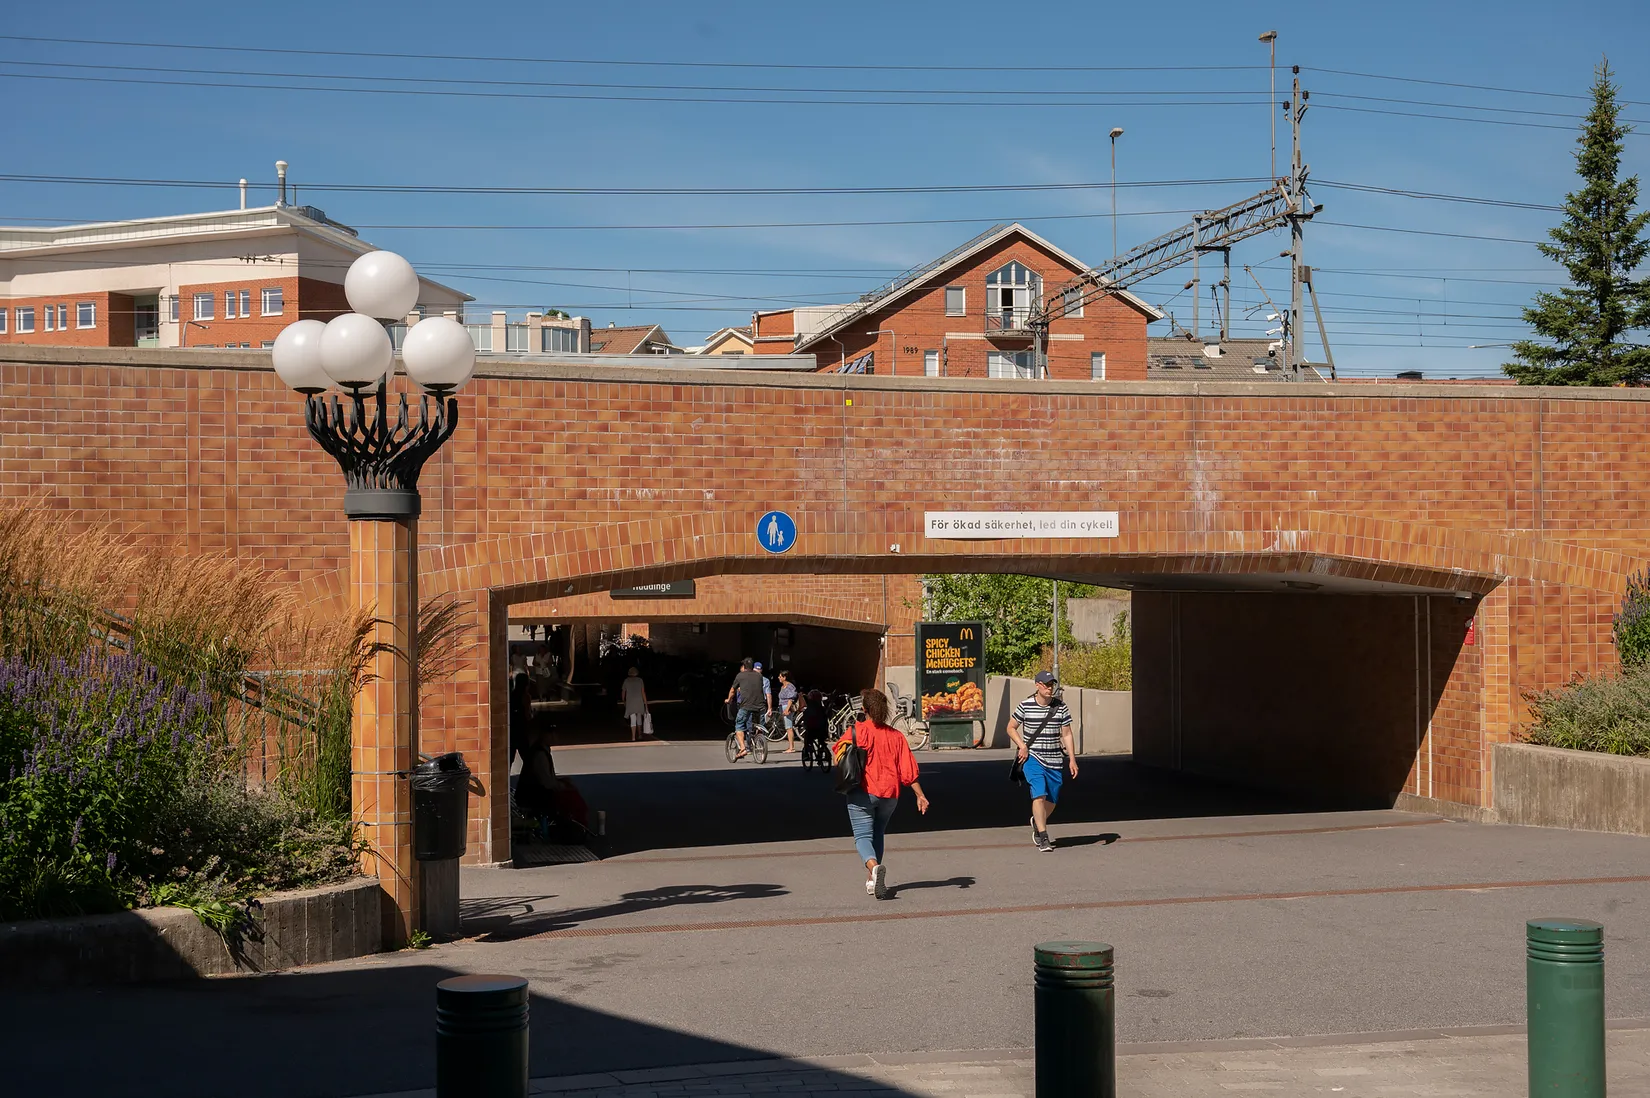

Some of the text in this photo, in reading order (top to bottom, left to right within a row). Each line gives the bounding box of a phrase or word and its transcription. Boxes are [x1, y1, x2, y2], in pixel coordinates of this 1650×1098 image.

[903, 346, 919, 354] 1989
[931, 519, 1113, 531] För ökad säkerhet, led din cykel!
[925, 638, 949, 648] SPICY
[925, 648, 960, 658] CHICKEN
